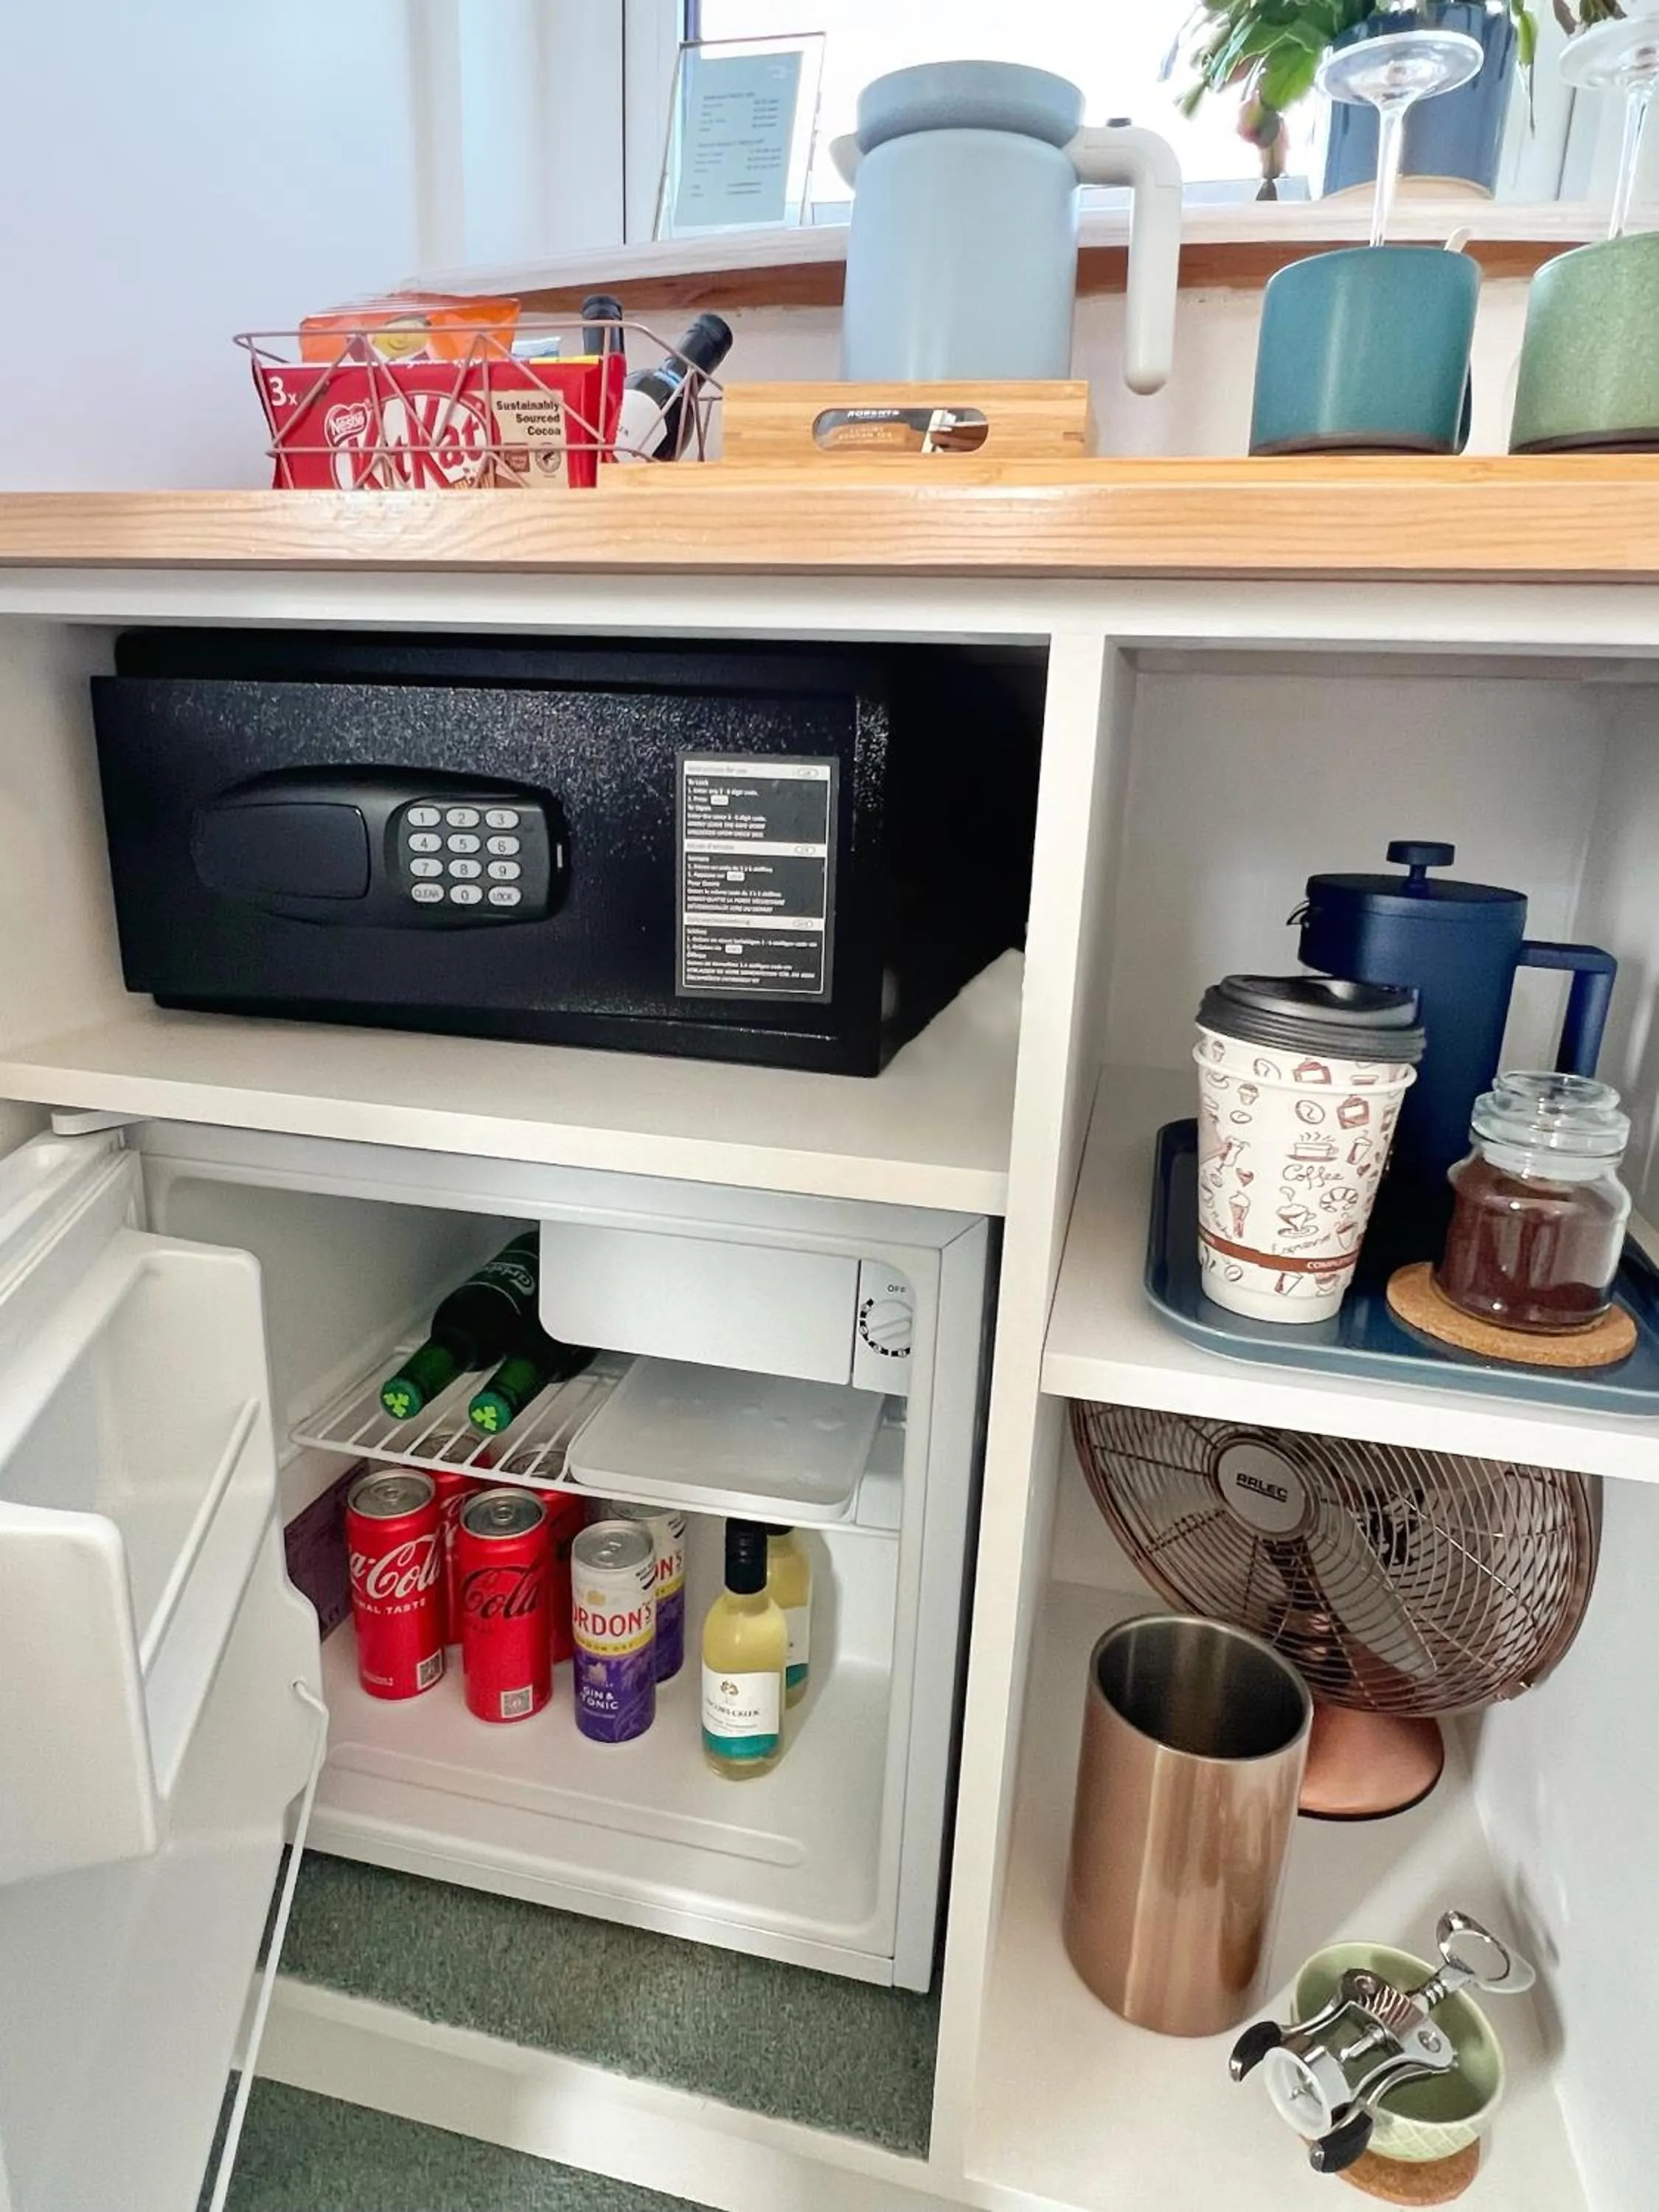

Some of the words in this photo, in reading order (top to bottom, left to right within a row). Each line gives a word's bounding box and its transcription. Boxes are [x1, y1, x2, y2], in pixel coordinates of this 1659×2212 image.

[496, 400, 560, 413] Sustainably
[515, 414, 560, 424] Sourced
[527, 427, 561, 437] Cocoa
[458, 813, 466, 824] 2
[497, 814, 504, 825] 3
[420, 838, 428, 849] 4
[459, 839, 467, 849] 5
[498, 841, 507, 852] 6
[422, 863, 429, 873] 7
[459, 864, 468, 875] 8
[498, 866, 507, 877] 9
[461, 890, 470, 901] 0
[1283, 1164, 1344, 1189] Coffee
[1237, 1473, 1287, 1498] ARLEC
[386, 1599, 425, 1615] TASTE
[583, 1686, 604, 1700] GIN
[580, 1691, 619, 1710] TONIC
